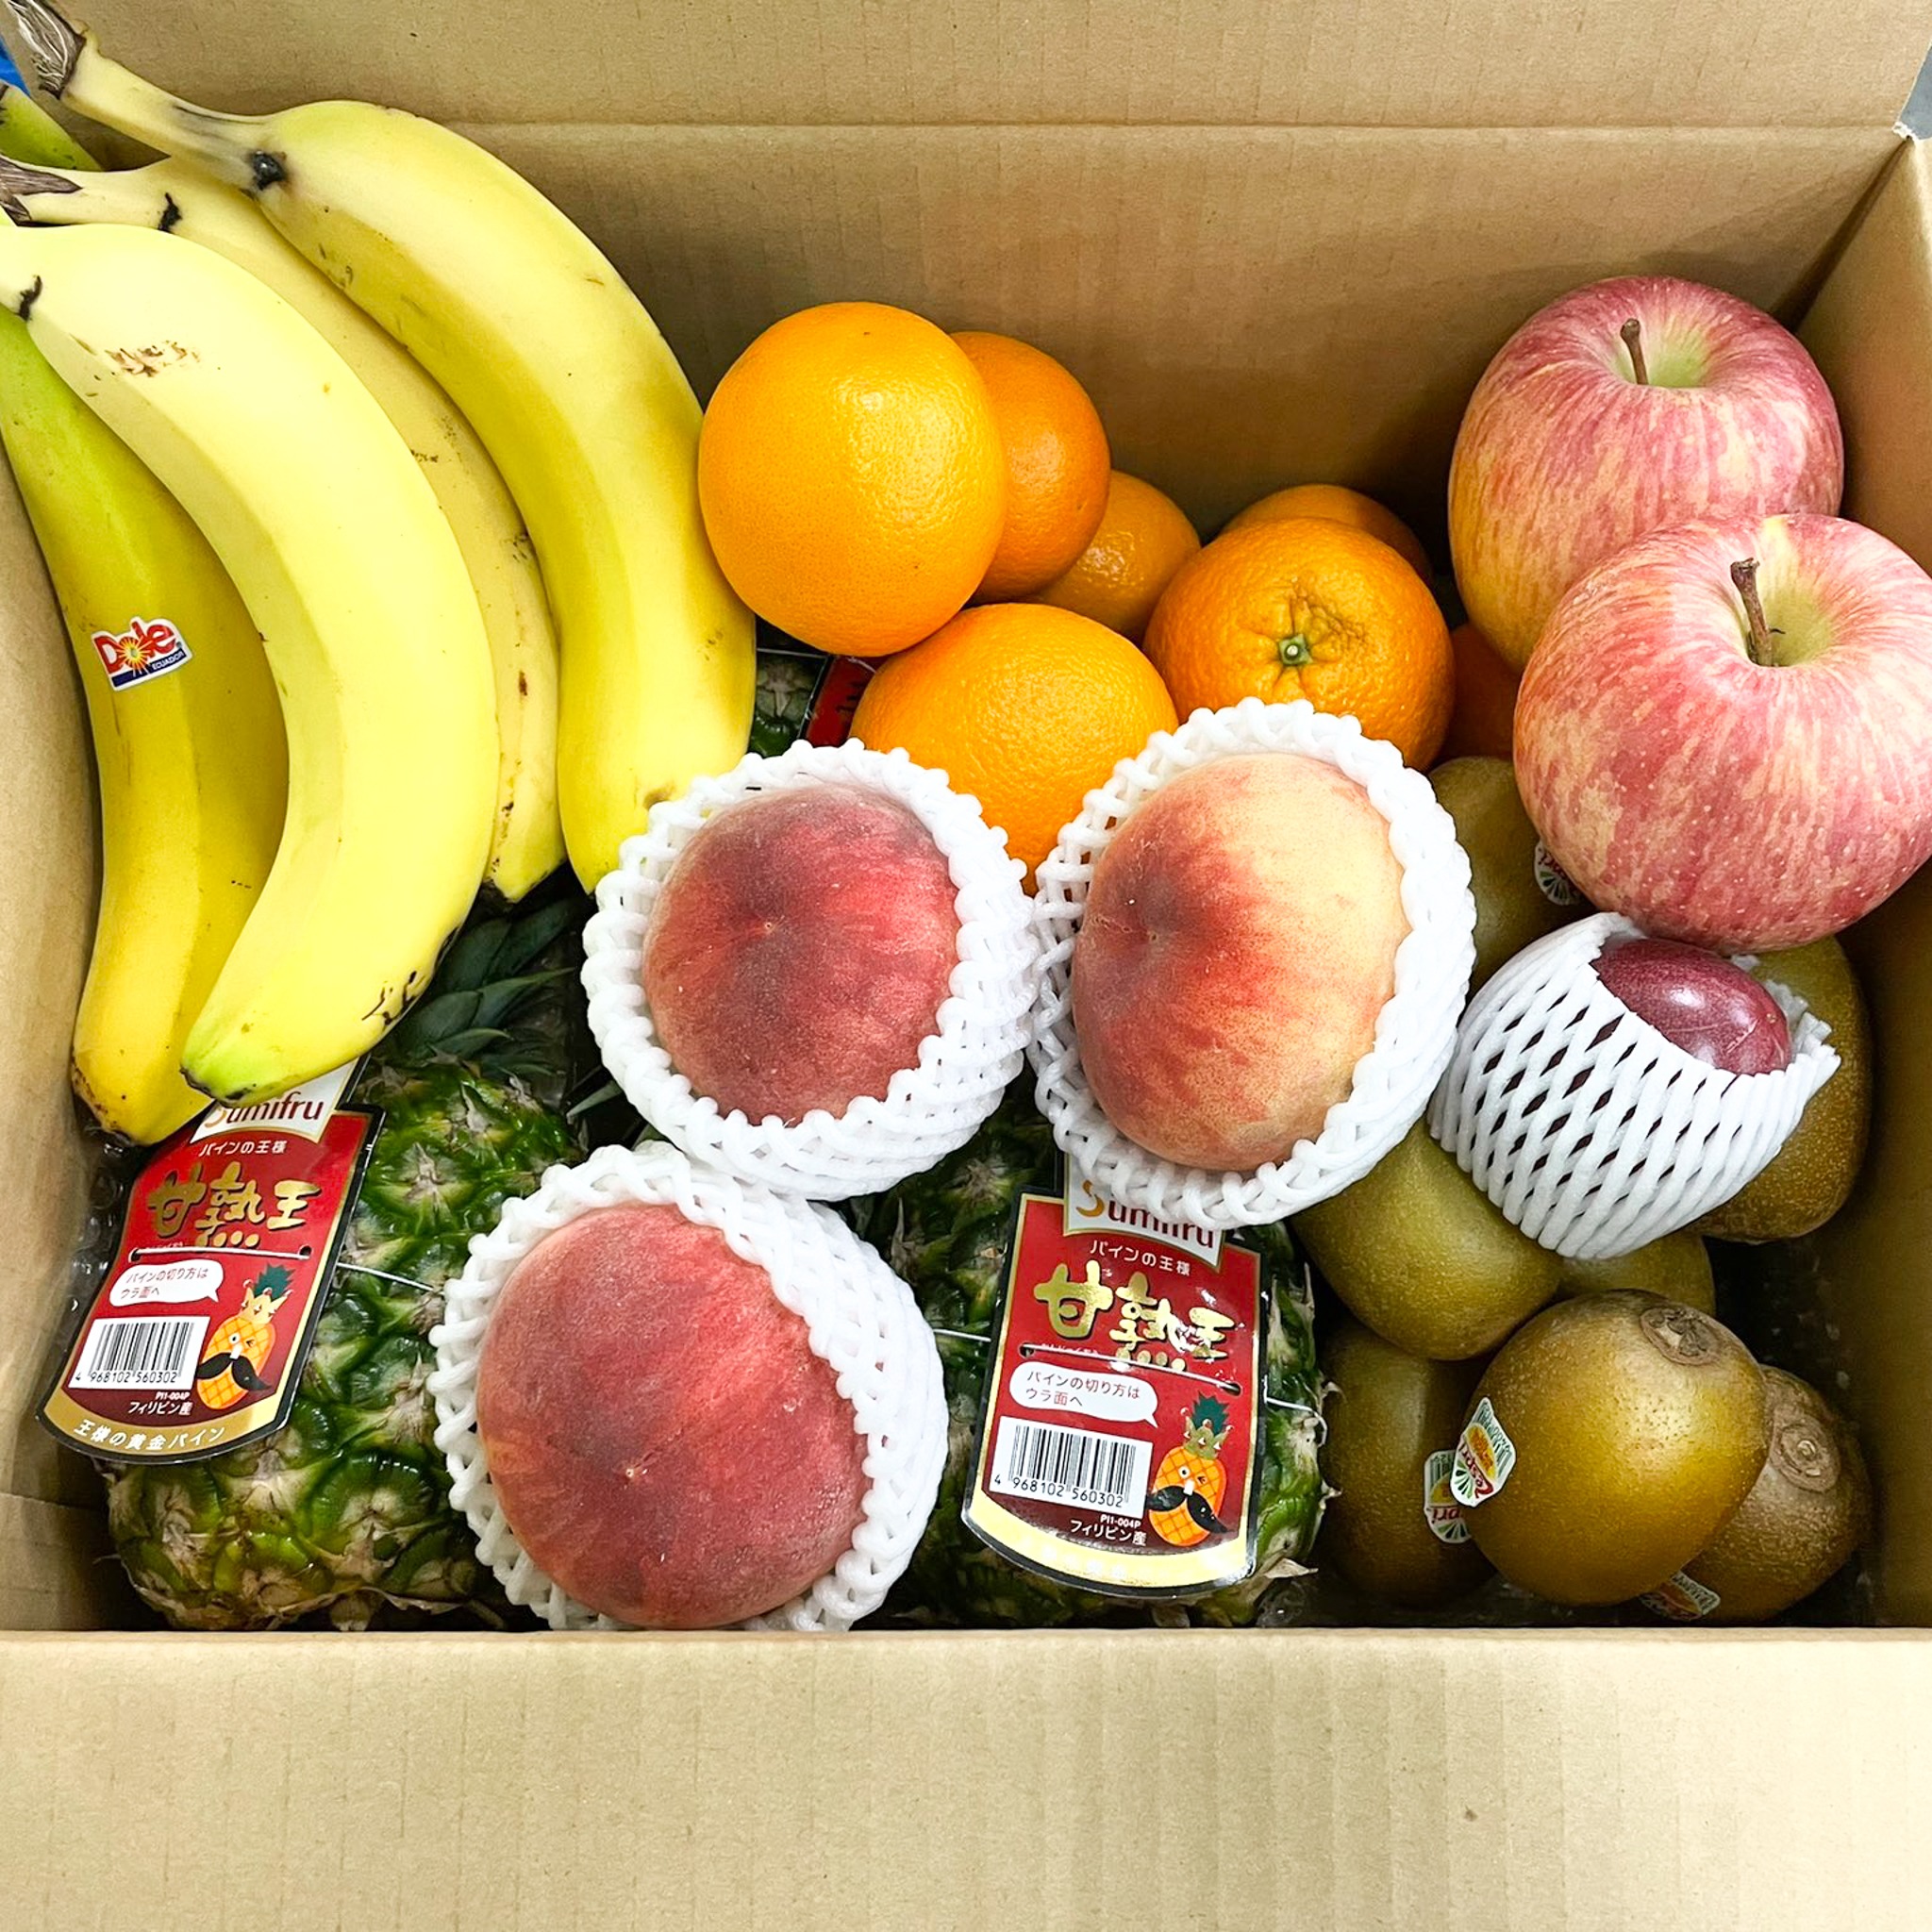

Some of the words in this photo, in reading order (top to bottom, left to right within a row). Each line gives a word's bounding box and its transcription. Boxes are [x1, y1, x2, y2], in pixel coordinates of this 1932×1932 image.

[94, 621, 175, 674] Dole
[152, 650, 185, 671] ECUADOR
[198, 1140, 288, 1158] パインの王様
[145, 1160, 322, 1248] 甘熟王
[1089, 1239, 1191, 1277] パインの王様
[125, 1267, 208, 1284] パインの切り方は
[1033, 1259, 1235, 1373] 甘熟王
[75, 1373, 82, 1382] 4
[90, 1372, 131, 1384] 968102
[136, 1372, 178, 1384] 560302
[1026, 1370, 1141, 1400] パインの切り方は
[127, 1401, 194, 1416] フィリピン産
[1025, 1387, 1083, 1407] ウラ面へ
[73, 1419, 225, 1451] 王様の黄金パイン
[994, 1474, 1002, 1488] 4
[1011, 1474, 1065, 1498] 968102
[1071, 1484, 1124, 1507] 560302
[1070, 1519, 1148, 1547] フィリピン産
